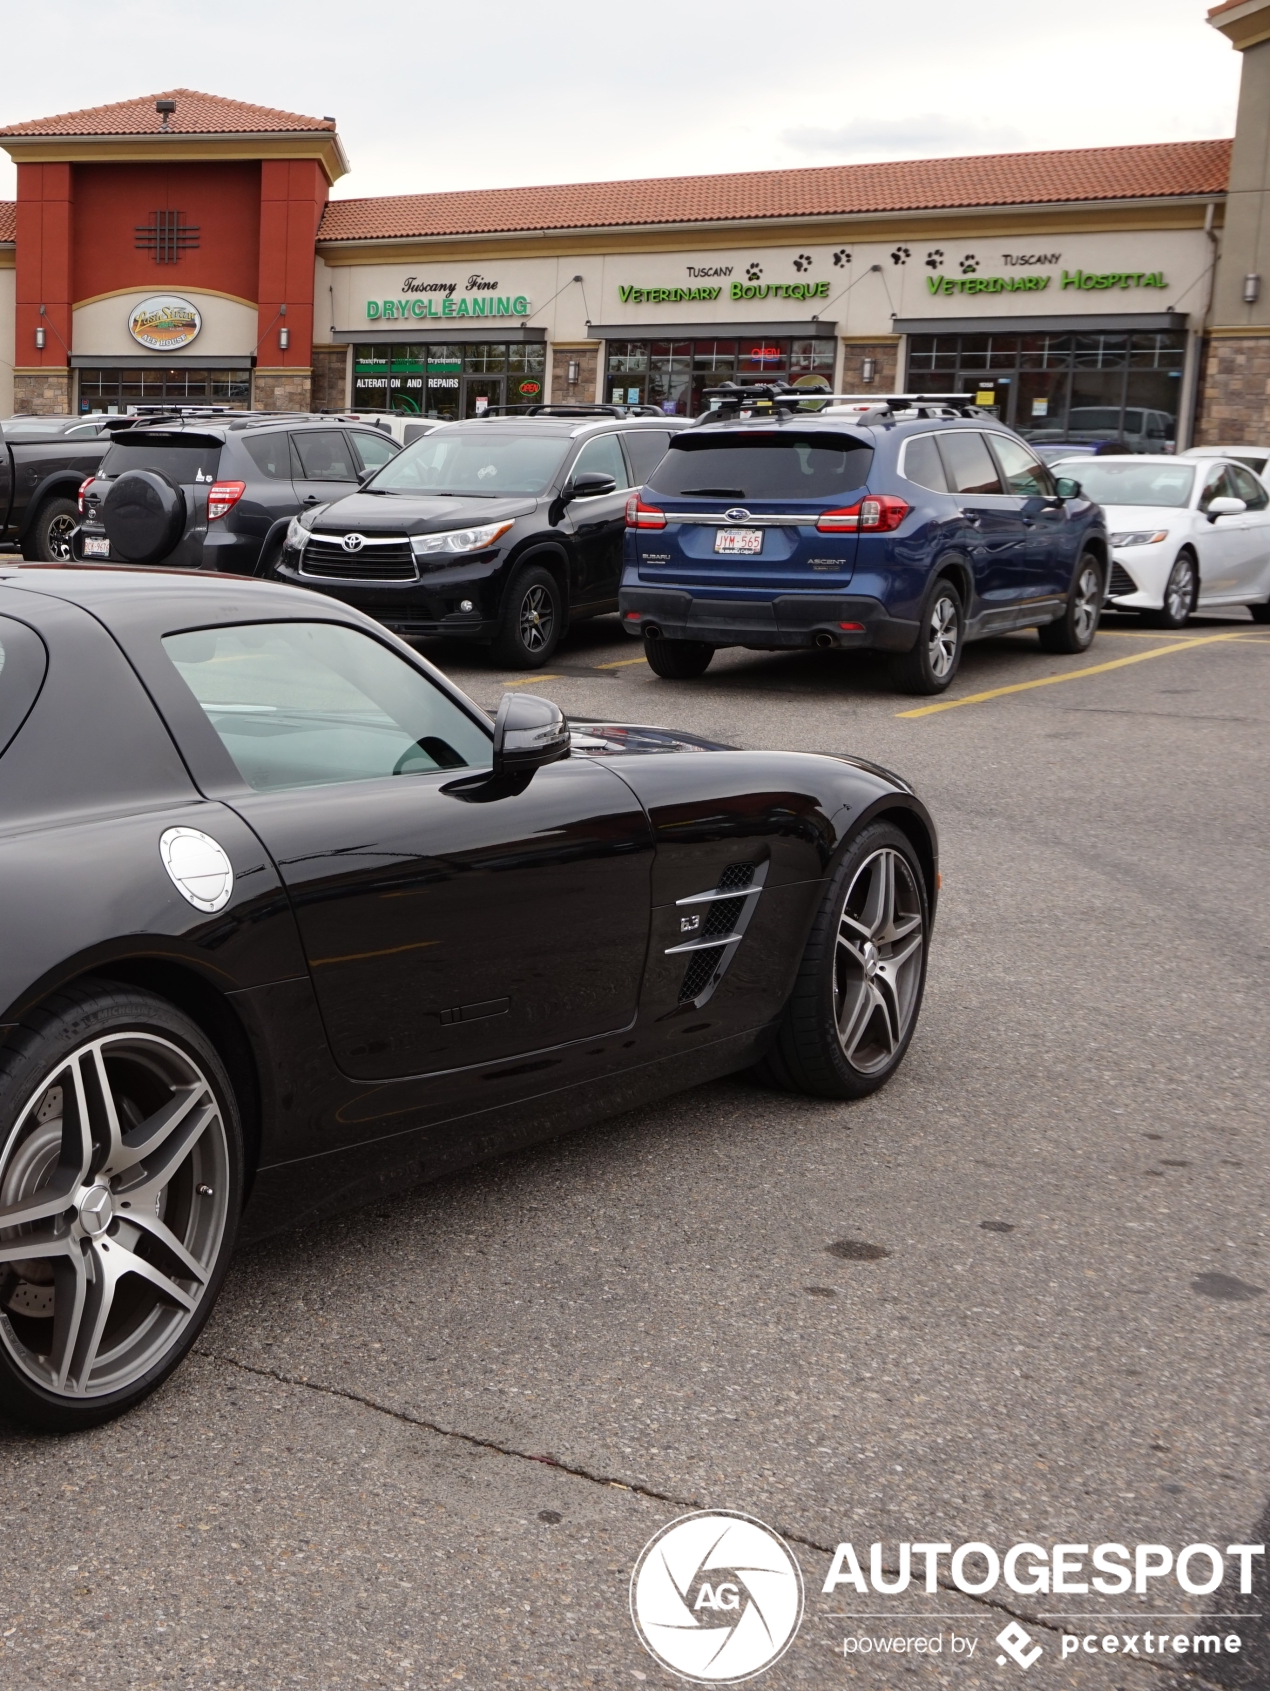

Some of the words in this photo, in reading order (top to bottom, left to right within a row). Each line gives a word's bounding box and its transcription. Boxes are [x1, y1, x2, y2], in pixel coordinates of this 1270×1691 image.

[1001, 253, 1062, 266] TUSCANY
[687, 266, 733, 278] TUSCANY
[402, 277, 457, 298] Tuscany
[465, 274, 498, 291] Fine
[366, 296, 529, 319] DRYCLEANING
[141, 334, 158, 346] ALE
[159, 333, 187, 347] HOUSE
[751, 348, 781, 359] OPEN
[407, 378, 422, 388] AND
[428, 378, 459, 388] REPAIRS
[521, 383, 539, 392] OPEN
[97, 1004, 148, 1019] MICHELIN
